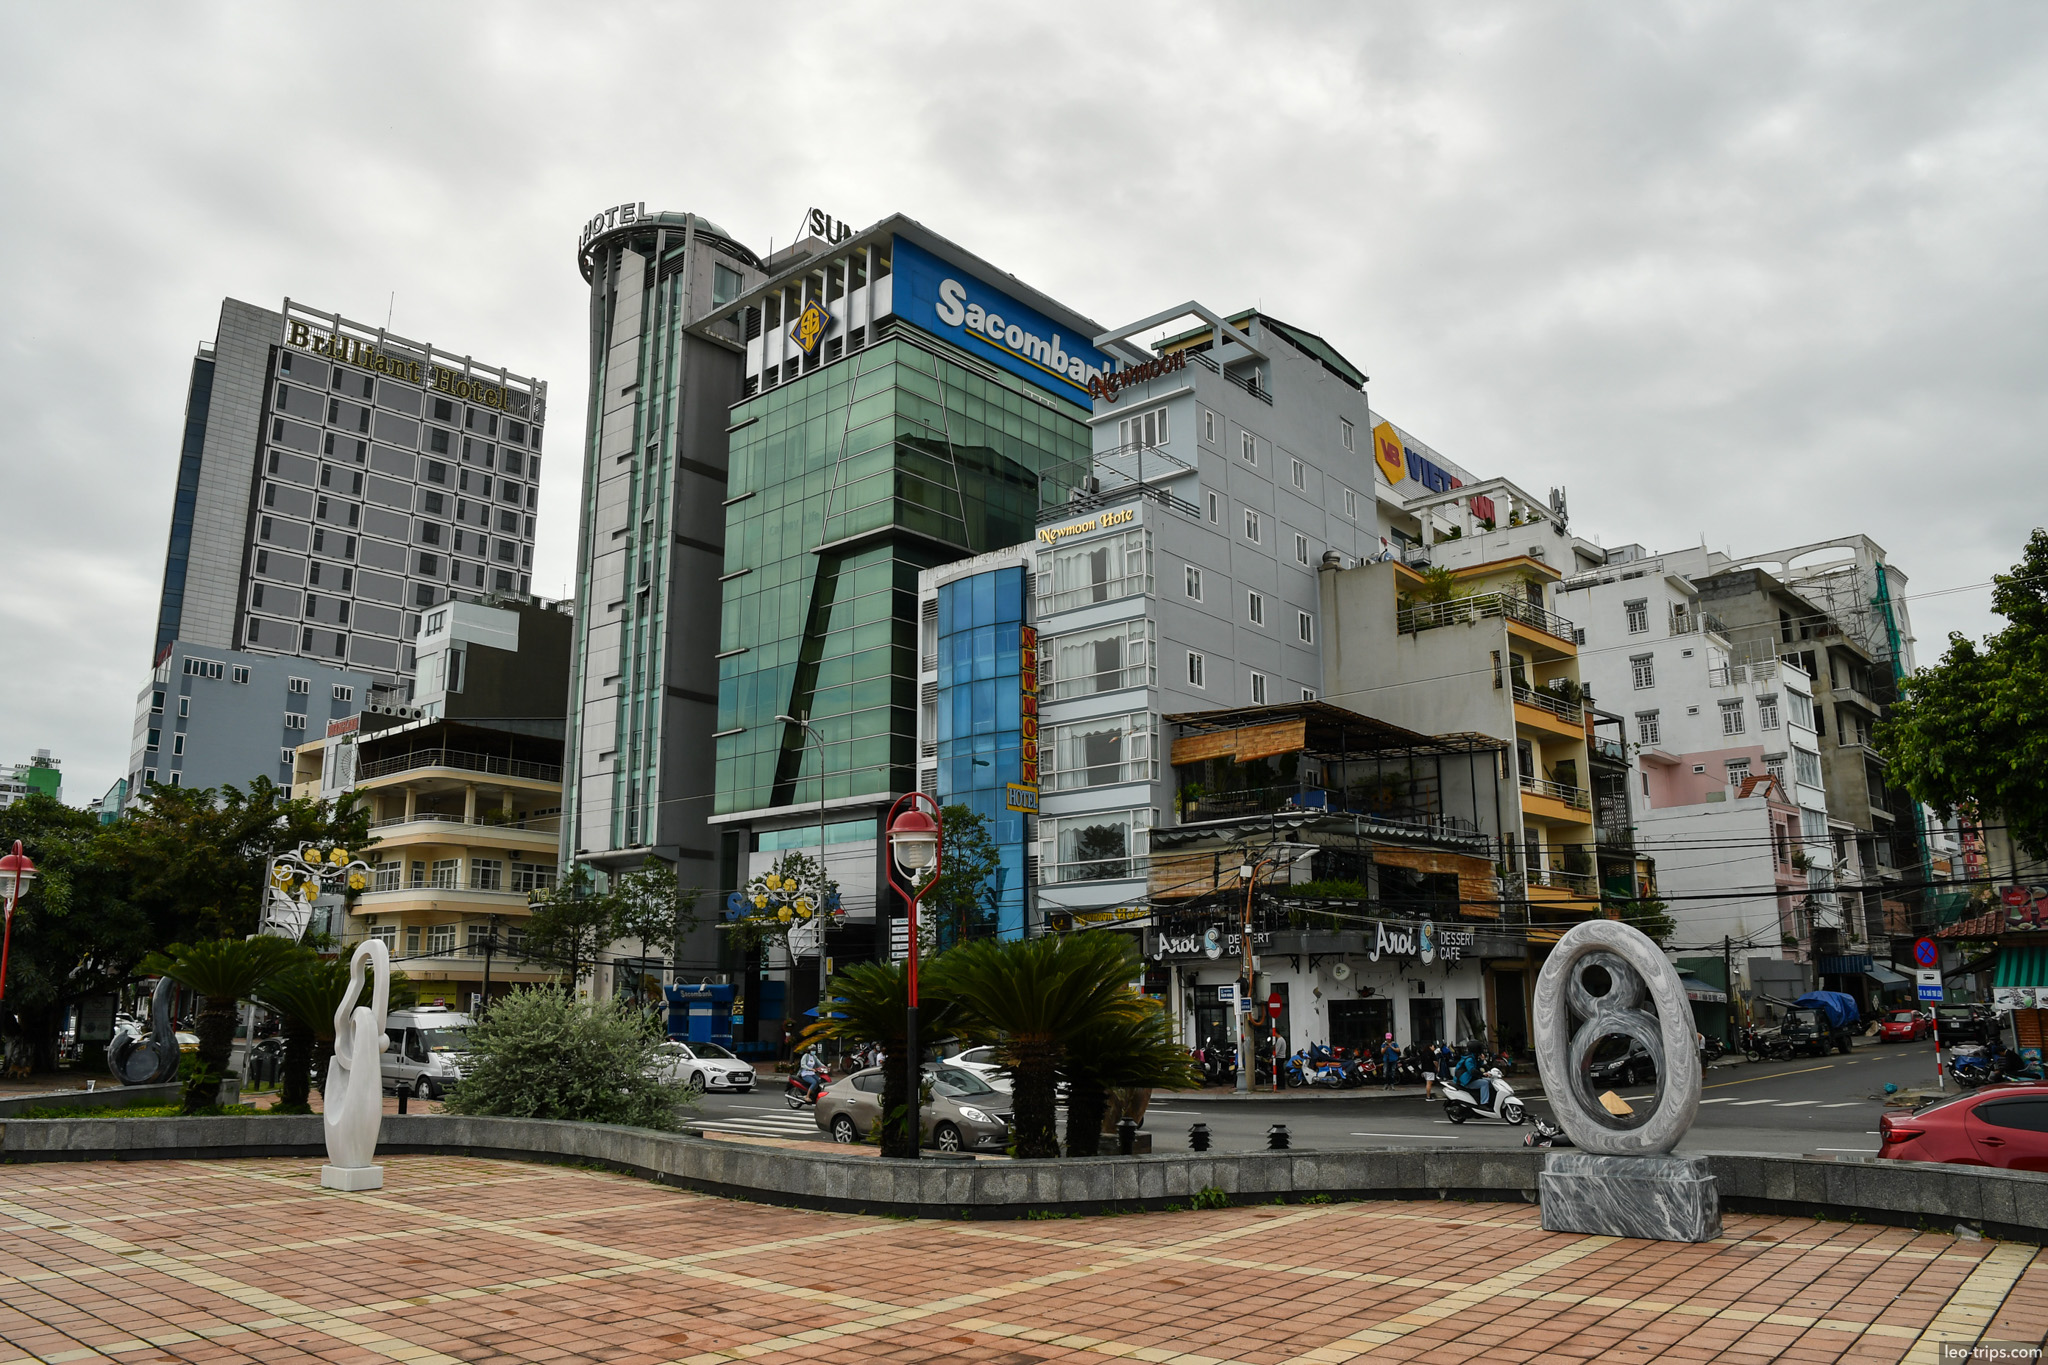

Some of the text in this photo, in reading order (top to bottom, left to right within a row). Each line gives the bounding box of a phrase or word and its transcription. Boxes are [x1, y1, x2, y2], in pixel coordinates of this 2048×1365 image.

[582, 202, 653, 246] HOTEL
[287, 320, 508, 410] Brilliant Hotel
[1087, 349, 1187, 403] Newmoon
[1038, 508, 1134, 544] Newmoon Hote
[1008, 787, 1038, 809] HOTEL
[1153, 932, 1199, 961] Aroi
[1369, 921, 1416, 962] Aroi
[1440, 932, 1474, 946] DESSERT
[1440, 947, 1461, 960] CAFE
[681, 989, 712, 998] Sacombank
